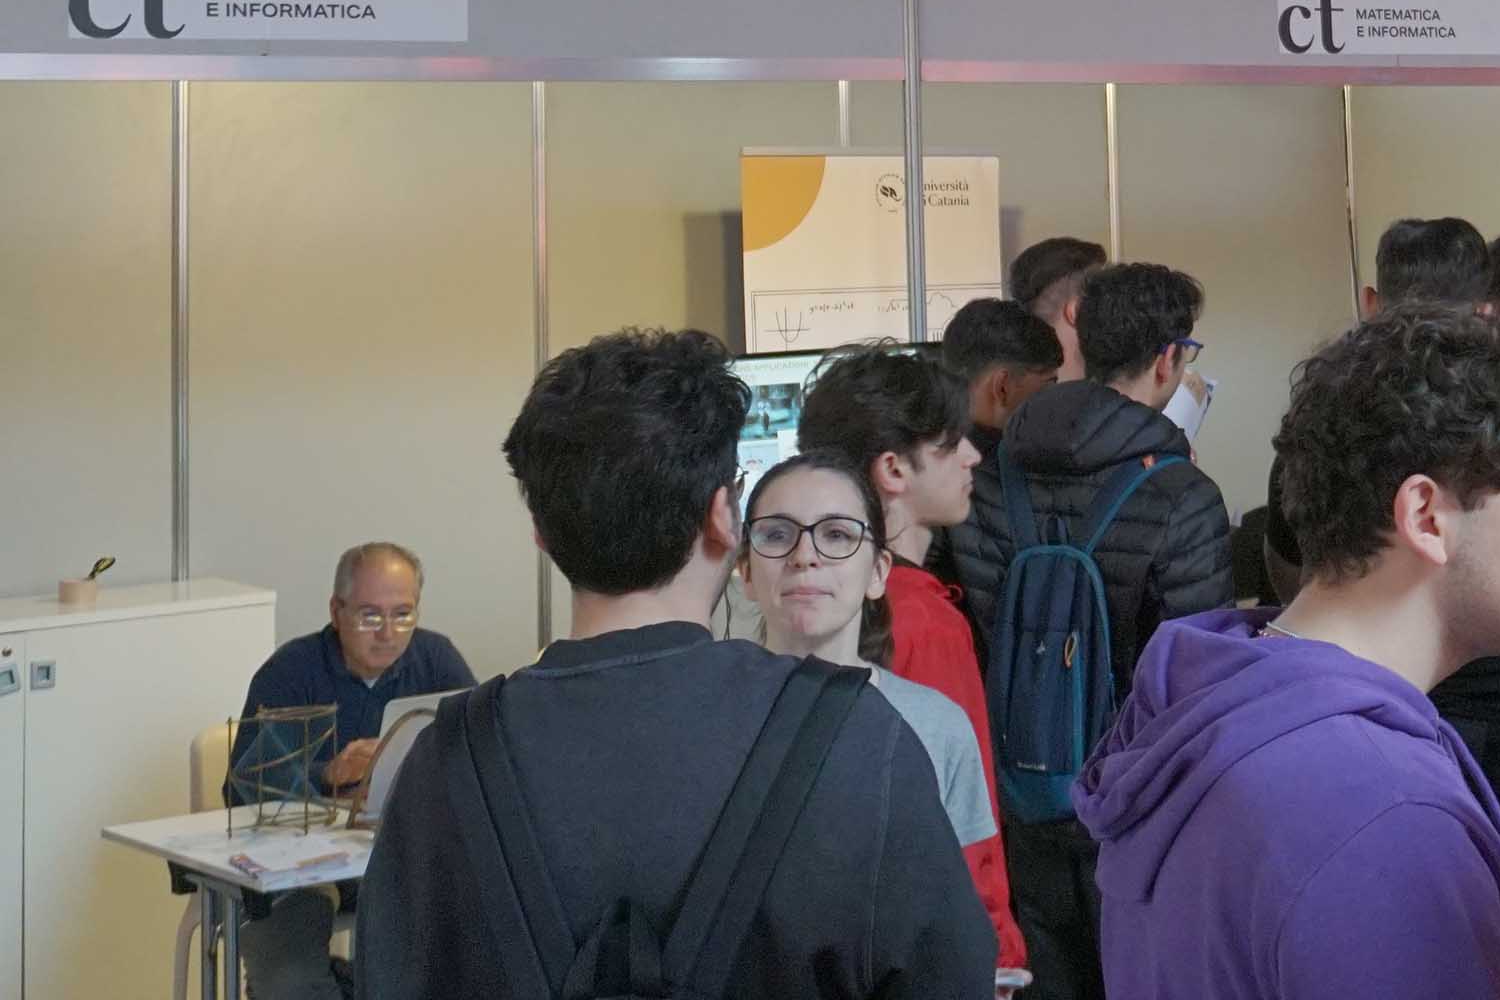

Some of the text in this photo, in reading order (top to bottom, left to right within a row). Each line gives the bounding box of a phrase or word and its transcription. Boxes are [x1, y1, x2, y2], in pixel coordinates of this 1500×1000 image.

[206, 3, 376, 20] E INFORMATICA
[1355, 8, 1441, 21] MATEMATICA
[1356, 26, 1456, 38] E INFORMATICA
[921, 179, 969, 192] niversità
[928, 194, 970, 206] Catania
